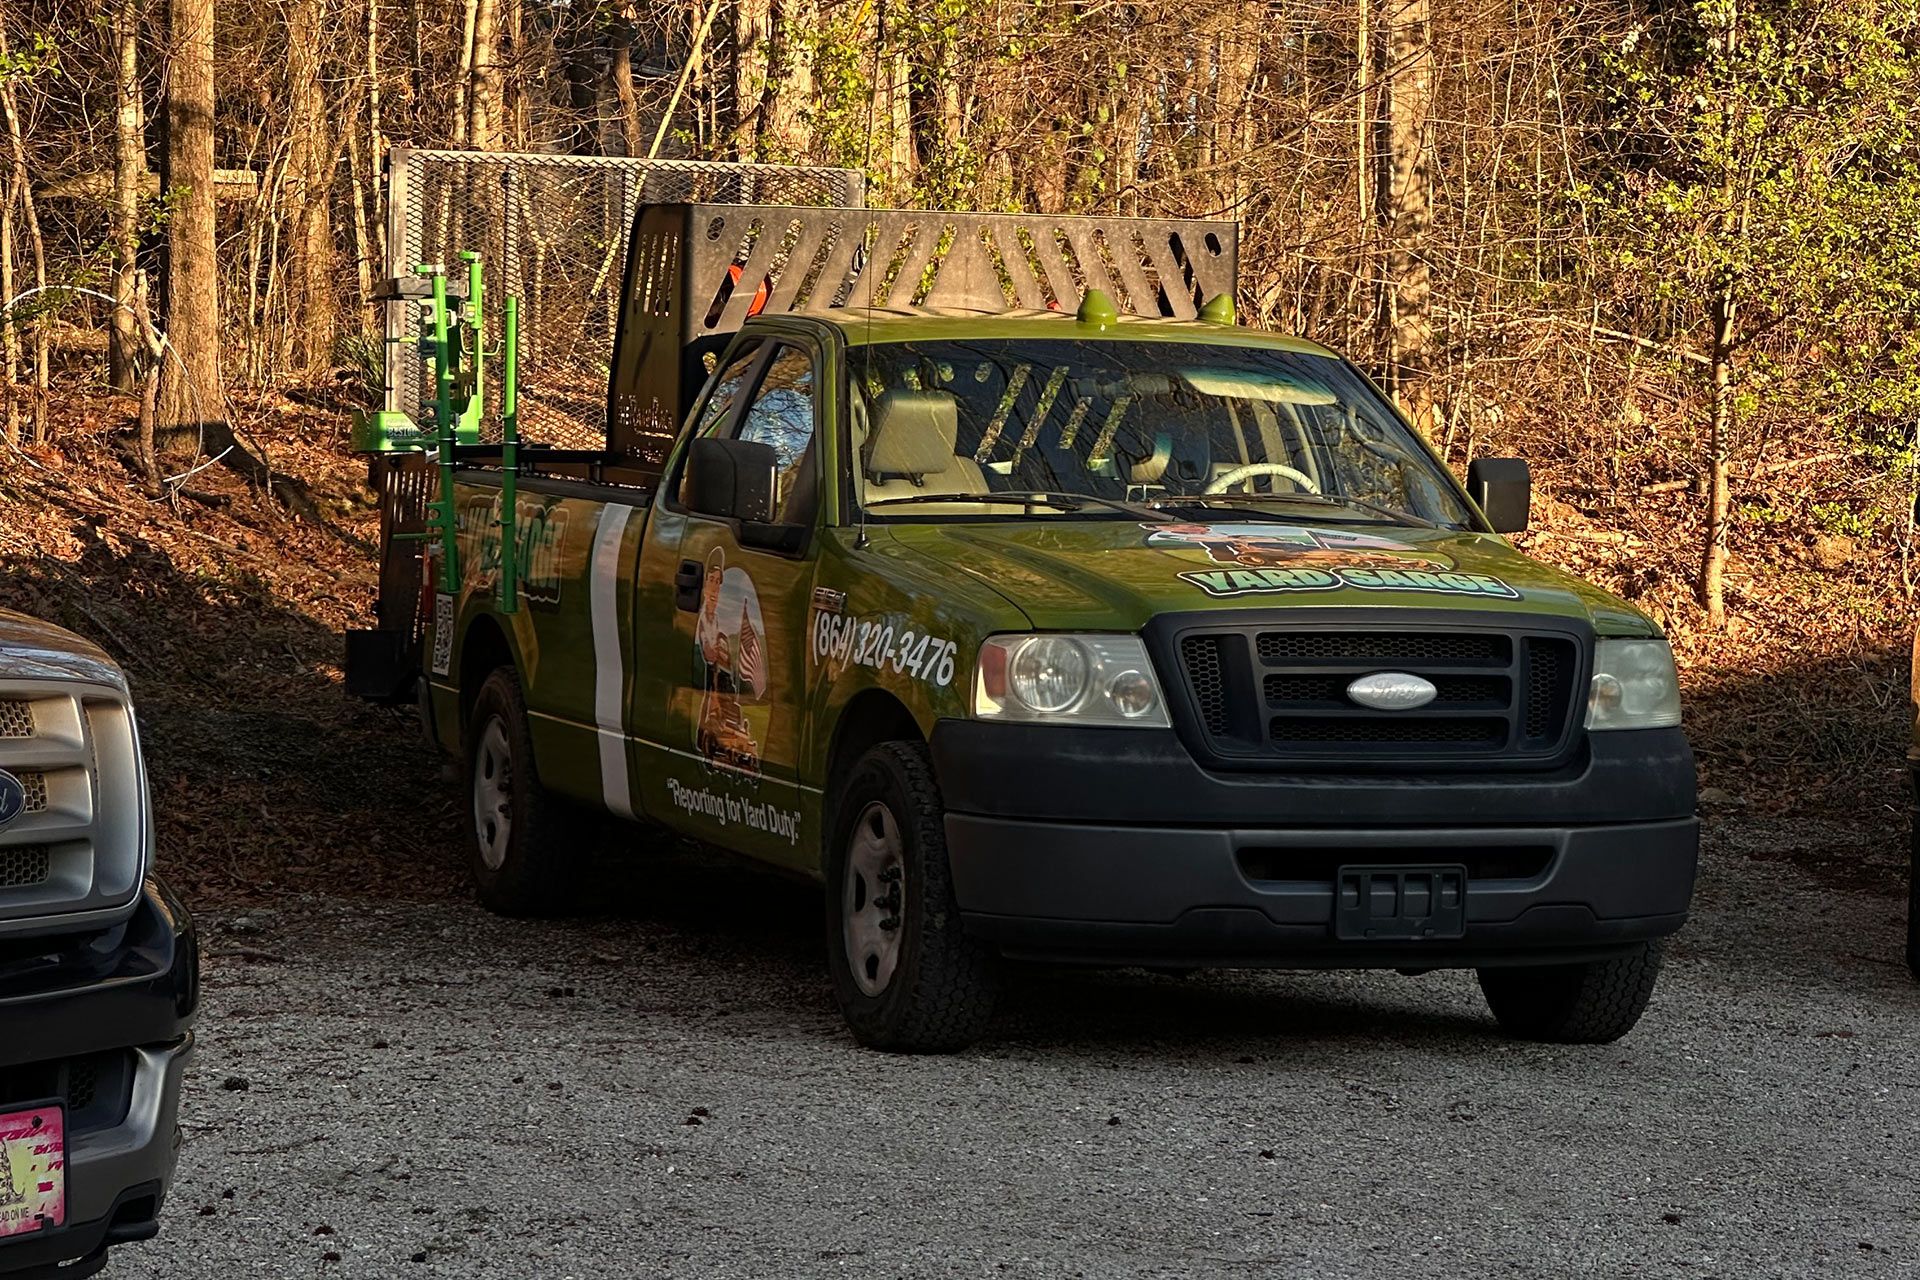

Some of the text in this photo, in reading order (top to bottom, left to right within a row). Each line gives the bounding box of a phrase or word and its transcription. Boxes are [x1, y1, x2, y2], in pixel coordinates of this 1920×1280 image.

[1189, 568, 1508, 594] YARD SARGE
[813, 610, 957, 686] (864) 320-3476
[725, 793, 741, 823] for
[740, 797, 768, 831] Yard
